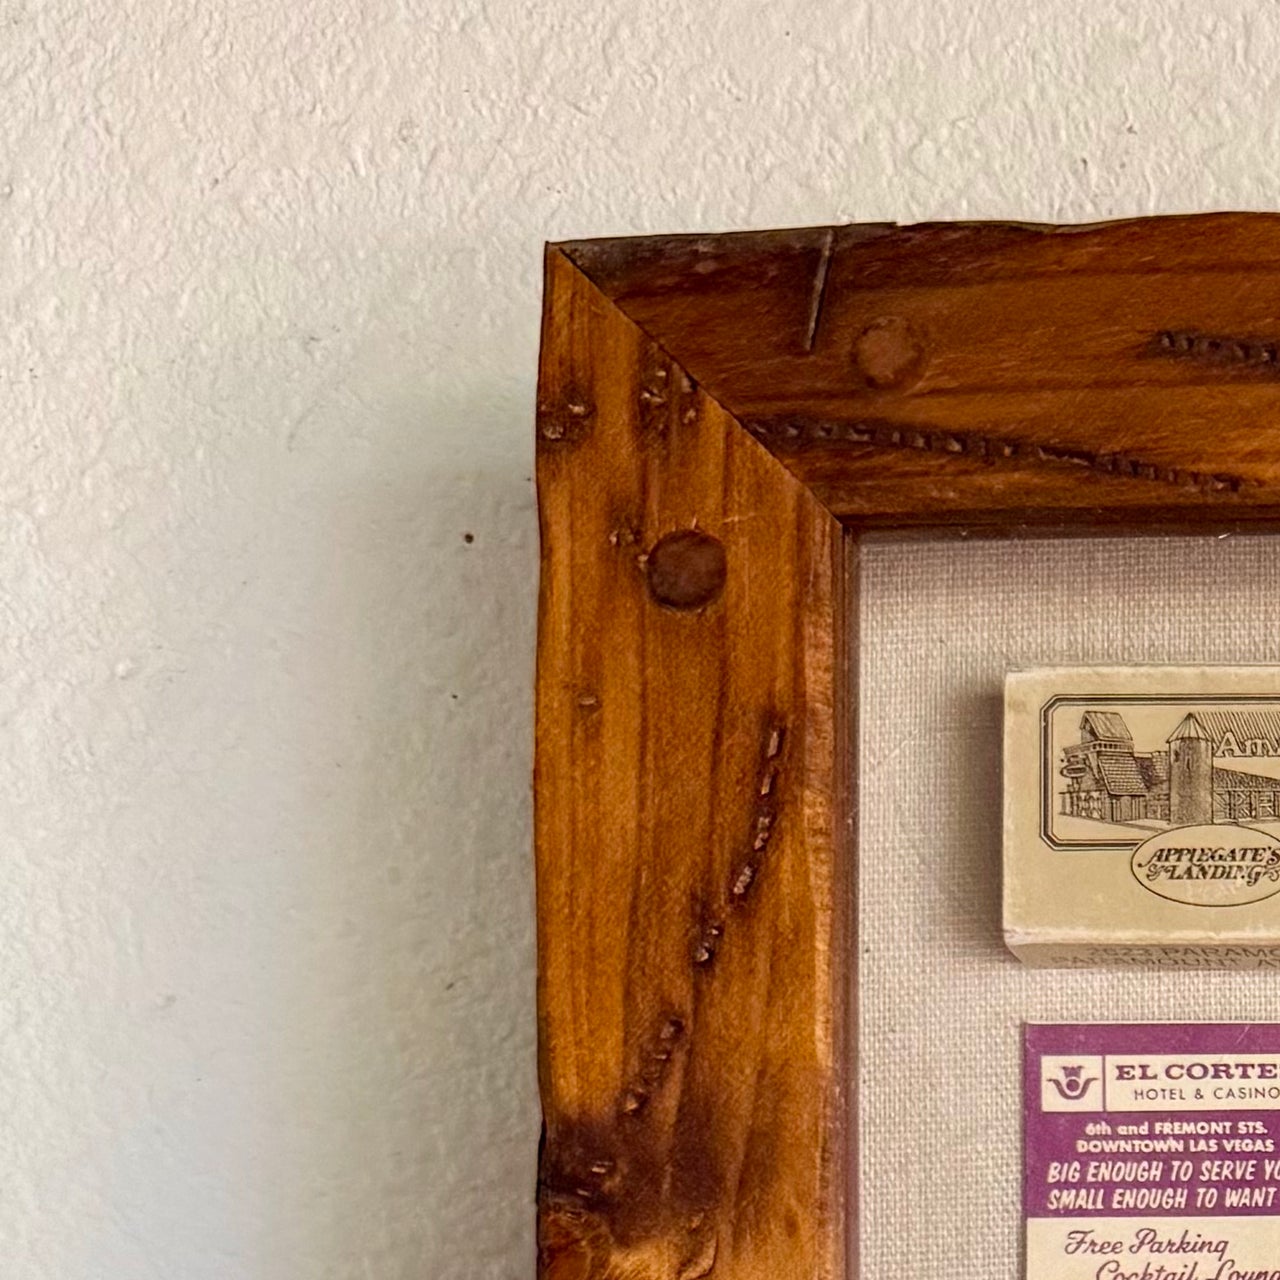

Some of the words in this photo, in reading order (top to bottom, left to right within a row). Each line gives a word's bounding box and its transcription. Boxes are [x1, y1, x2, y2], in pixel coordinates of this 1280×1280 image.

[1139, 846, 1280, 866] APPLEGATE'S
[1116, 1064, 1157, 1081] EL
[1135, 1087, 1186, 1100] HOTEL
[1213, 1086, 1280, 1099] CASINO
[1085, 1122, 1111, 1136] 6th
[1118, 1122, 1148, 1135] and
[1155, 1122, 1232, 1135] FREMONT
[1238, 1122, 1268, 1134] STS.
[1077, 1140, 1183, 1153] DOWNTOWN
[1189, 1139, 1218, 1152] LAS
[1224, 1139, 1274, 1152] VEGAS
[1047, 1161, 1081, 1183] BIG
[1087, 1161, 1163, 1182] ENOUGH
[1171, 1161, 1193, 1181] TO
[1200, 1160, 1255, 1181] SERVE
[1047, 1189, 1104, 1209] SMALL
[1113, 1188, 1187, 1209] ENOUGH
[1196, 1188, 1218, 1208] TO
[1225, 1187, 1276, 1208] WANT
[1064, 1229, 1122, 1255] Free
[1129, 1228, 1229, 1262] Parking
